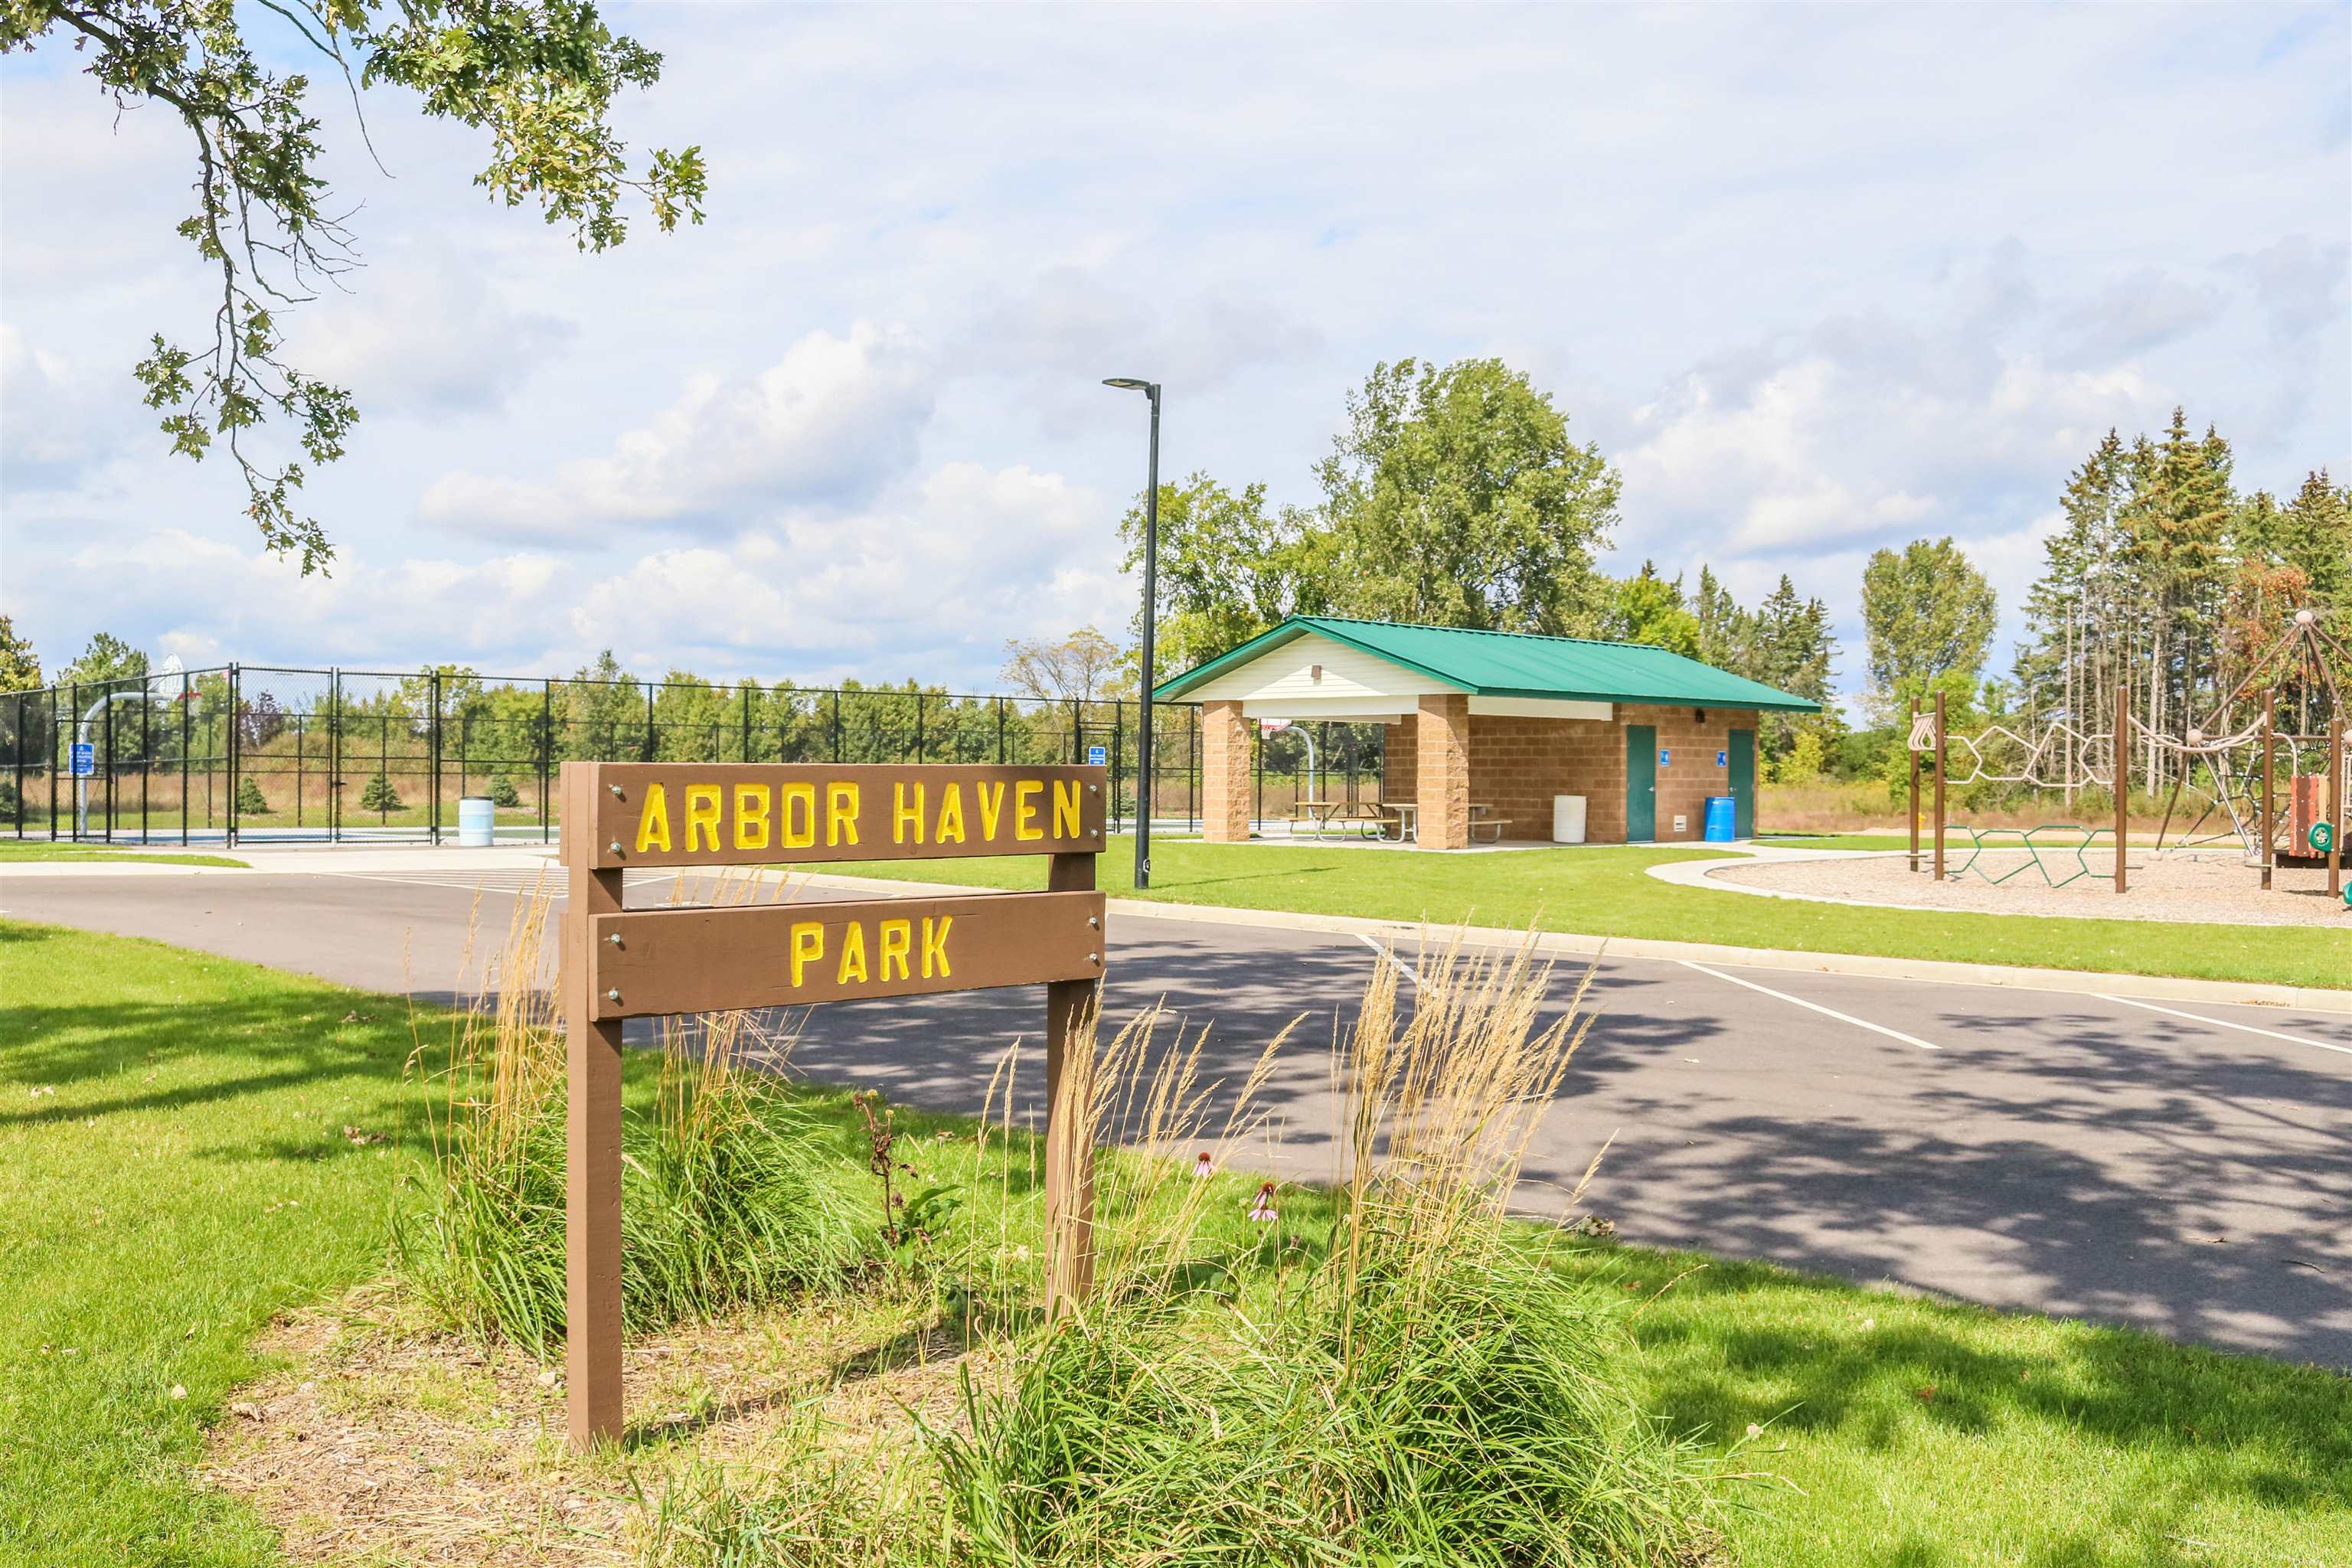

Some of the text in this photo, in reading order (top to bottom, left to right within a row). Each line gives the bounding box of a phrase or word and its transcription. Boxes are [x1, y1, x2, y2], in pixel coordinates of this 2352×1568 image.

[635, 779, 1082, 853] ARBOR HAVEN
[790, 916, 953, 988] PARK
